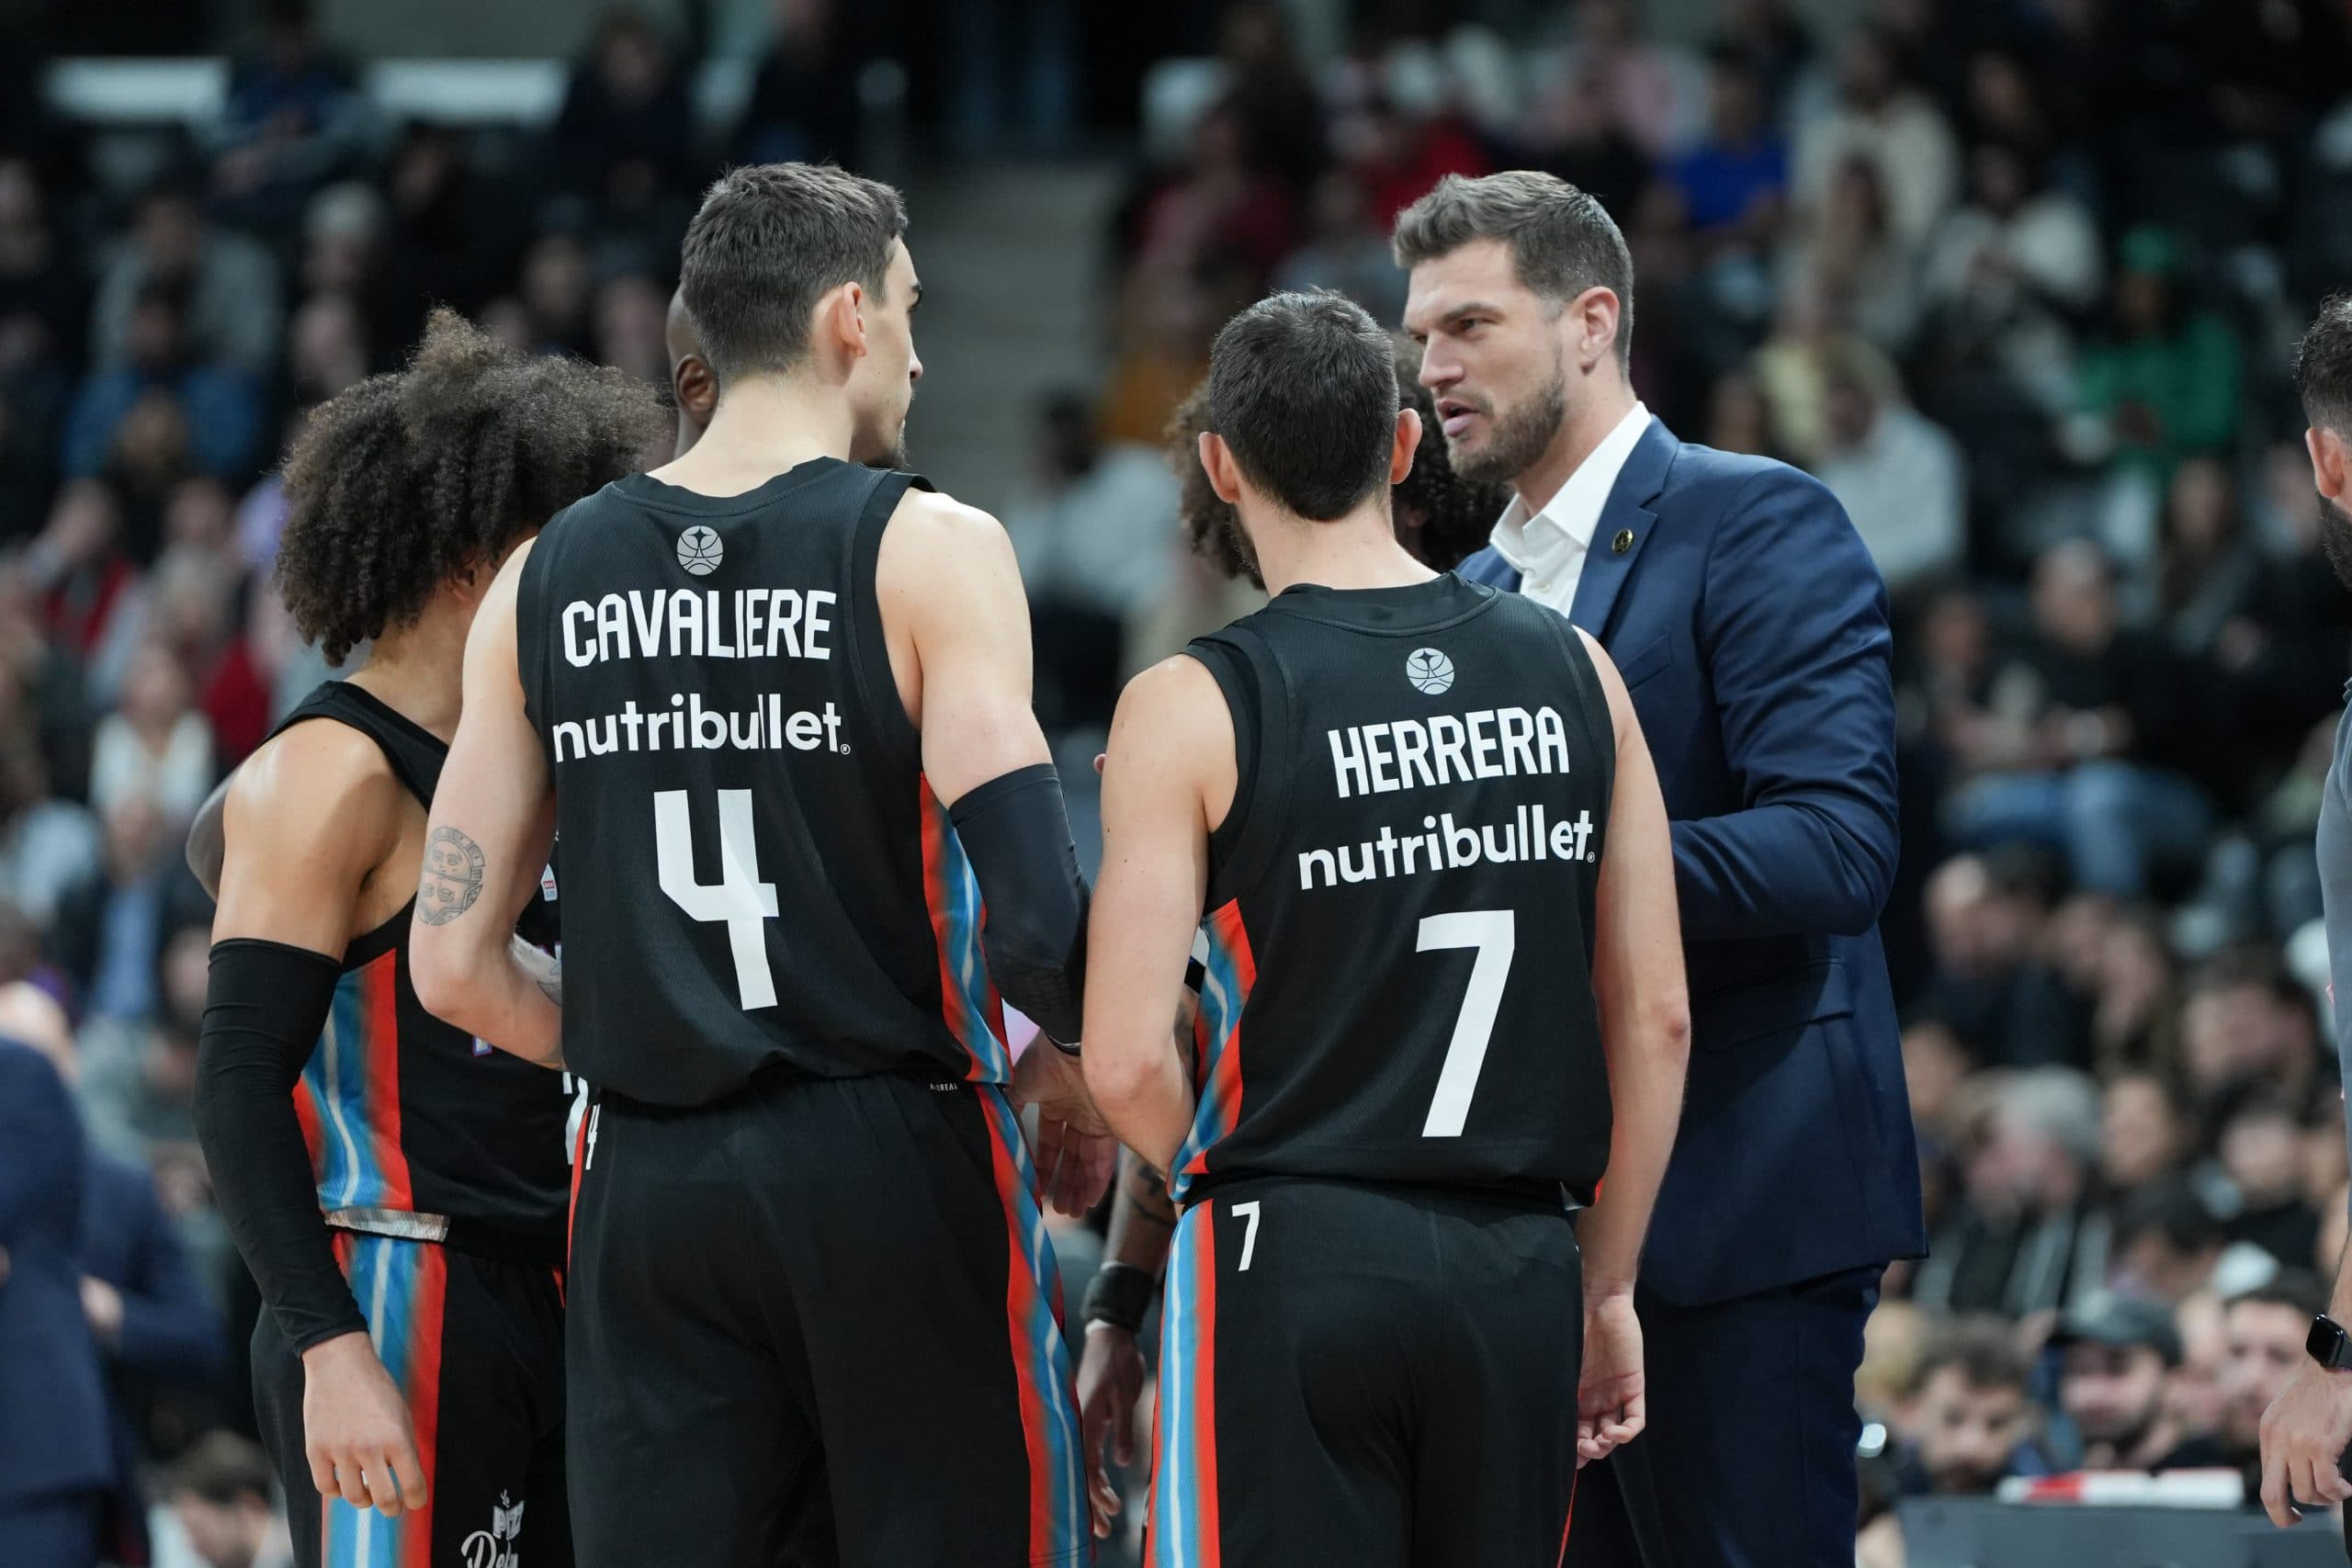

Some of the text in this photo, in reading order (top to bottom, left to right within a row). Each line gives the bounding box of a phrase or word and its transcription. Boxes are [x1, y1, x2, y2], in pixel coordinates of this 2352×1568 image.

[561, 588, 837, 668] CAVALIERE
[1328, 705, 1570, 798] HERRERA
[653, 788, 780, 1010] 4
[1416, 909, 1515, 1138] 7
[585, 1103, 601, 1170] 4
[1231, 1201, 1261, 1272] 7
